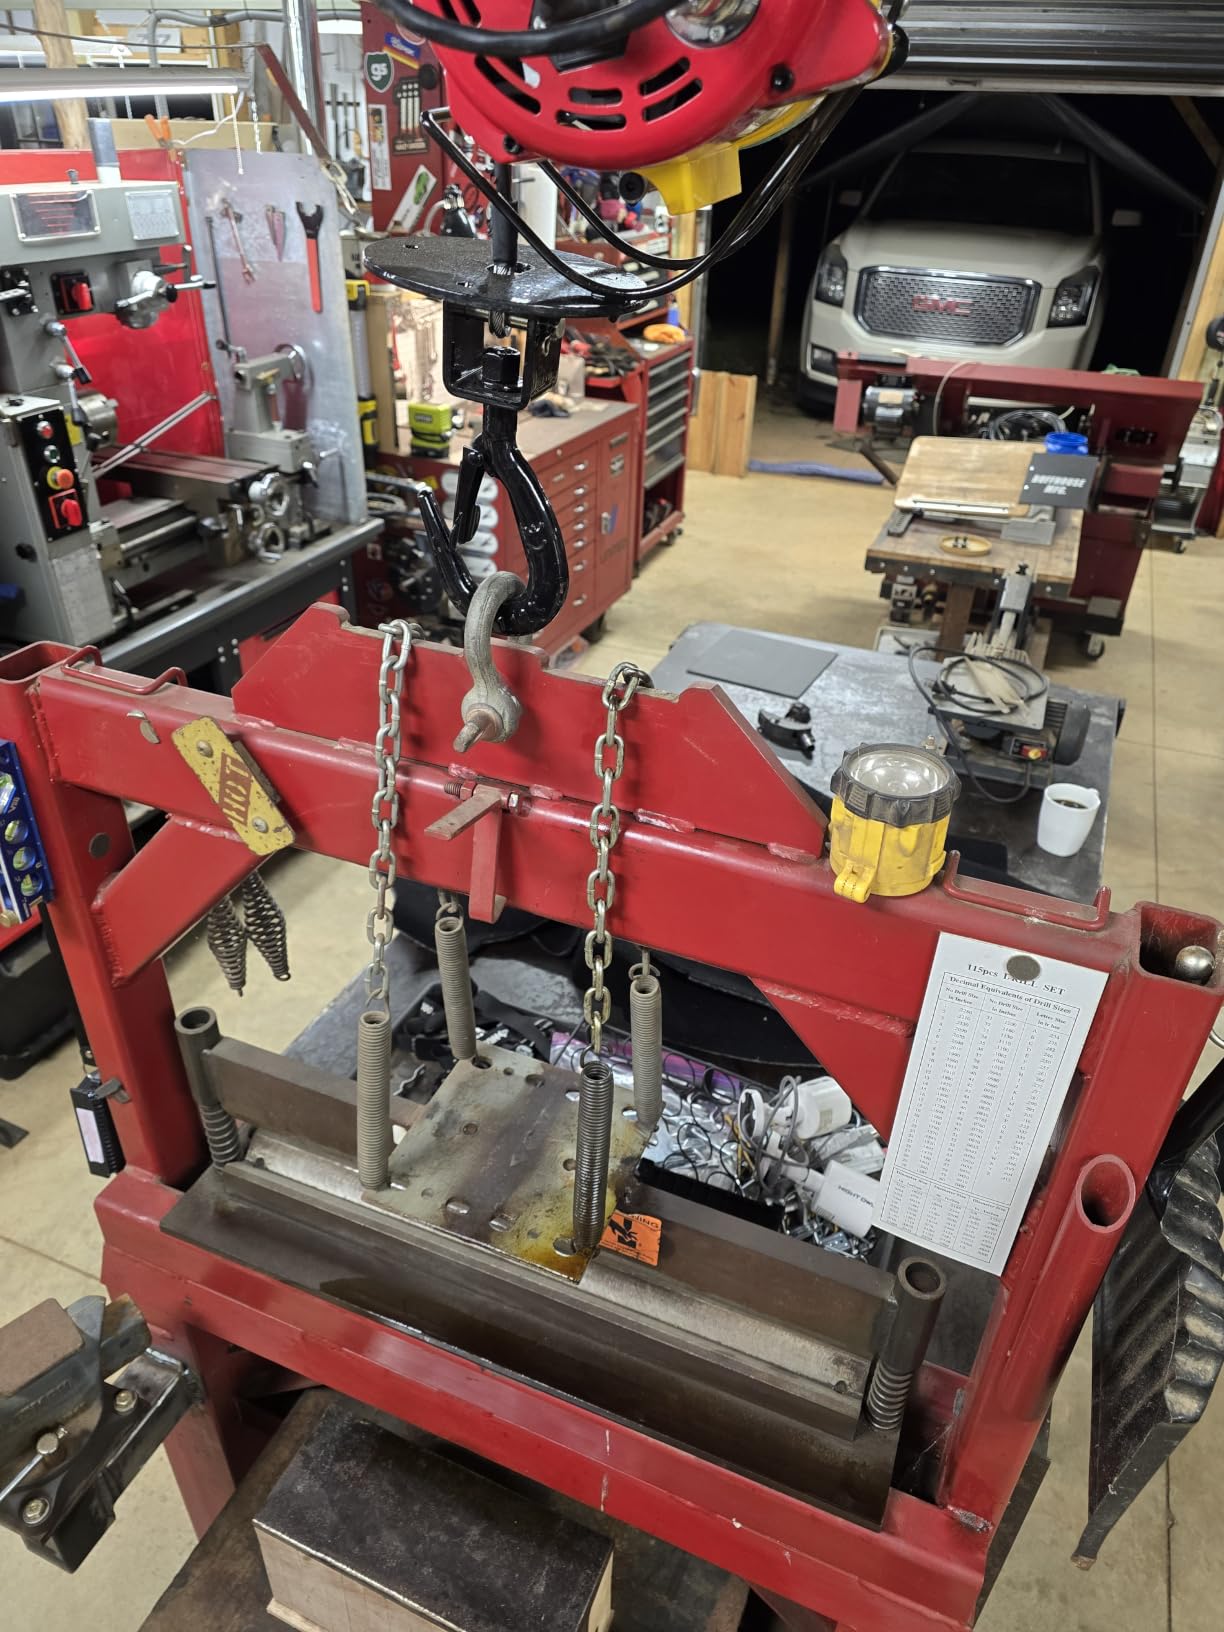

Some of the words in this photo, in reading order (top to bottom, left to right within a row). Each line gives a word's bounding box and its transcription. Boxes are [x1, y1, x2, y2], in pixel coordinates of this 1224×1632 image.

[912, 295, 973, 314] GMC
[222, 756, 249, 823] HOT
[949, 976, 979, 988] Decimal
[979, 984, 1023, 1000] Equivalents
[1032, 998, 1051, 1008] Drill
[1051, 1004, 1072, 1014] Sizes
[966, 963, 999, 978] 115pcs
[1042, 983, 1066, 995] SET
